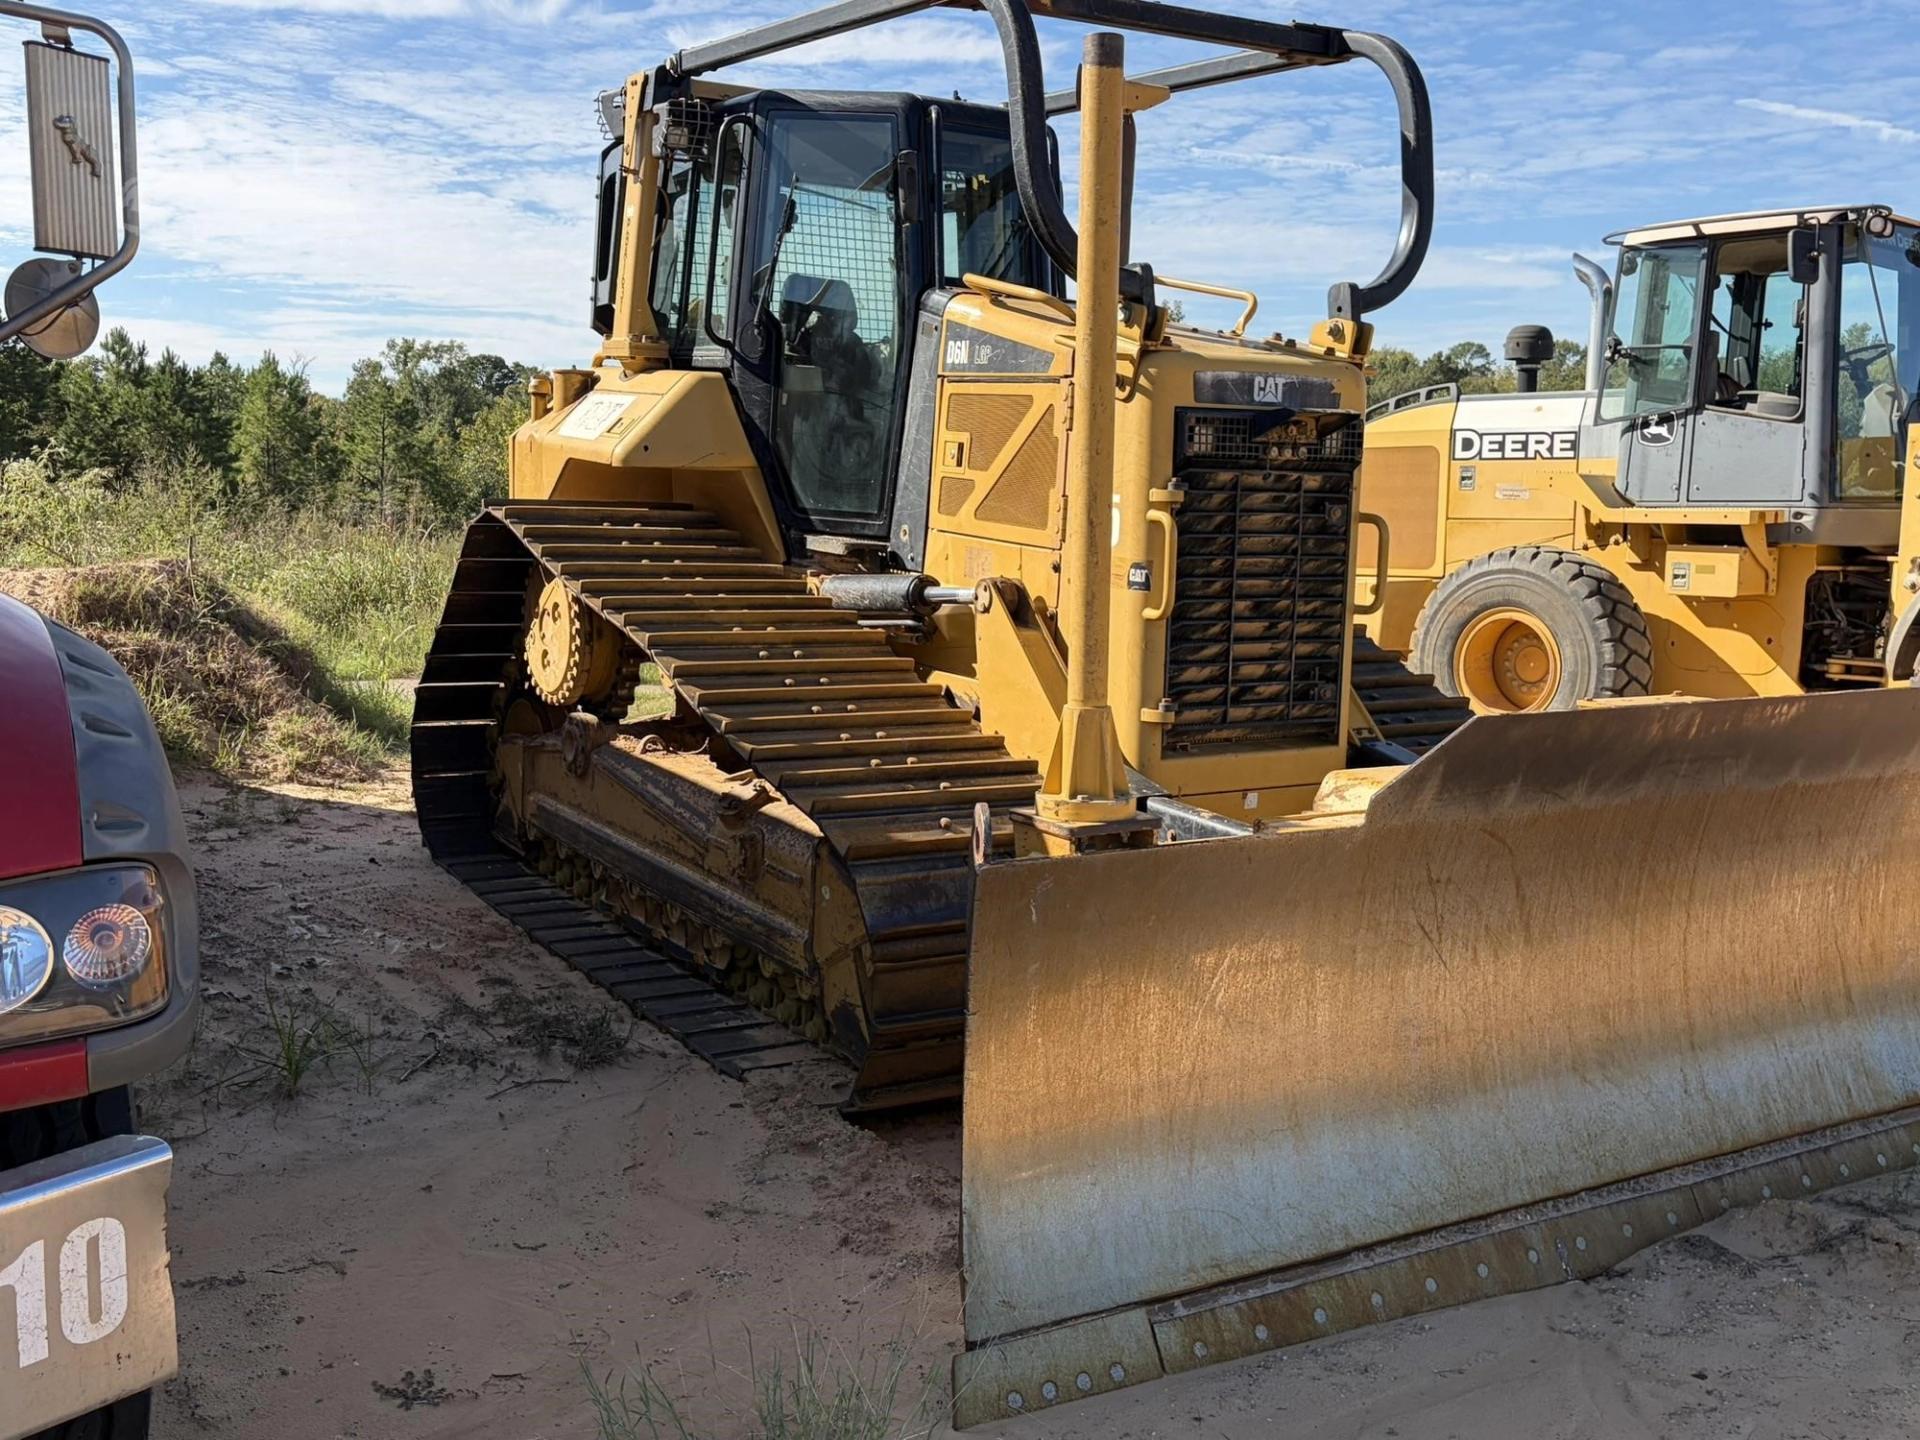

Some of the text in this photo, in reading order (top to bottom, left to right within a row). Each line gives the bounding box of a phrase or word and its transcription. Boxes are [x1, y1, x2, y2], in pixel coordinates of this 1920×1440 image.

[946, 340, 970, 365] D6N
[1253, 375, 1287, 403] CAT
[1454, 429, 1577, 460] DEERE
[1129, 568, 1148, 583] CAT
[0, 1217, 128, 1368] 10
